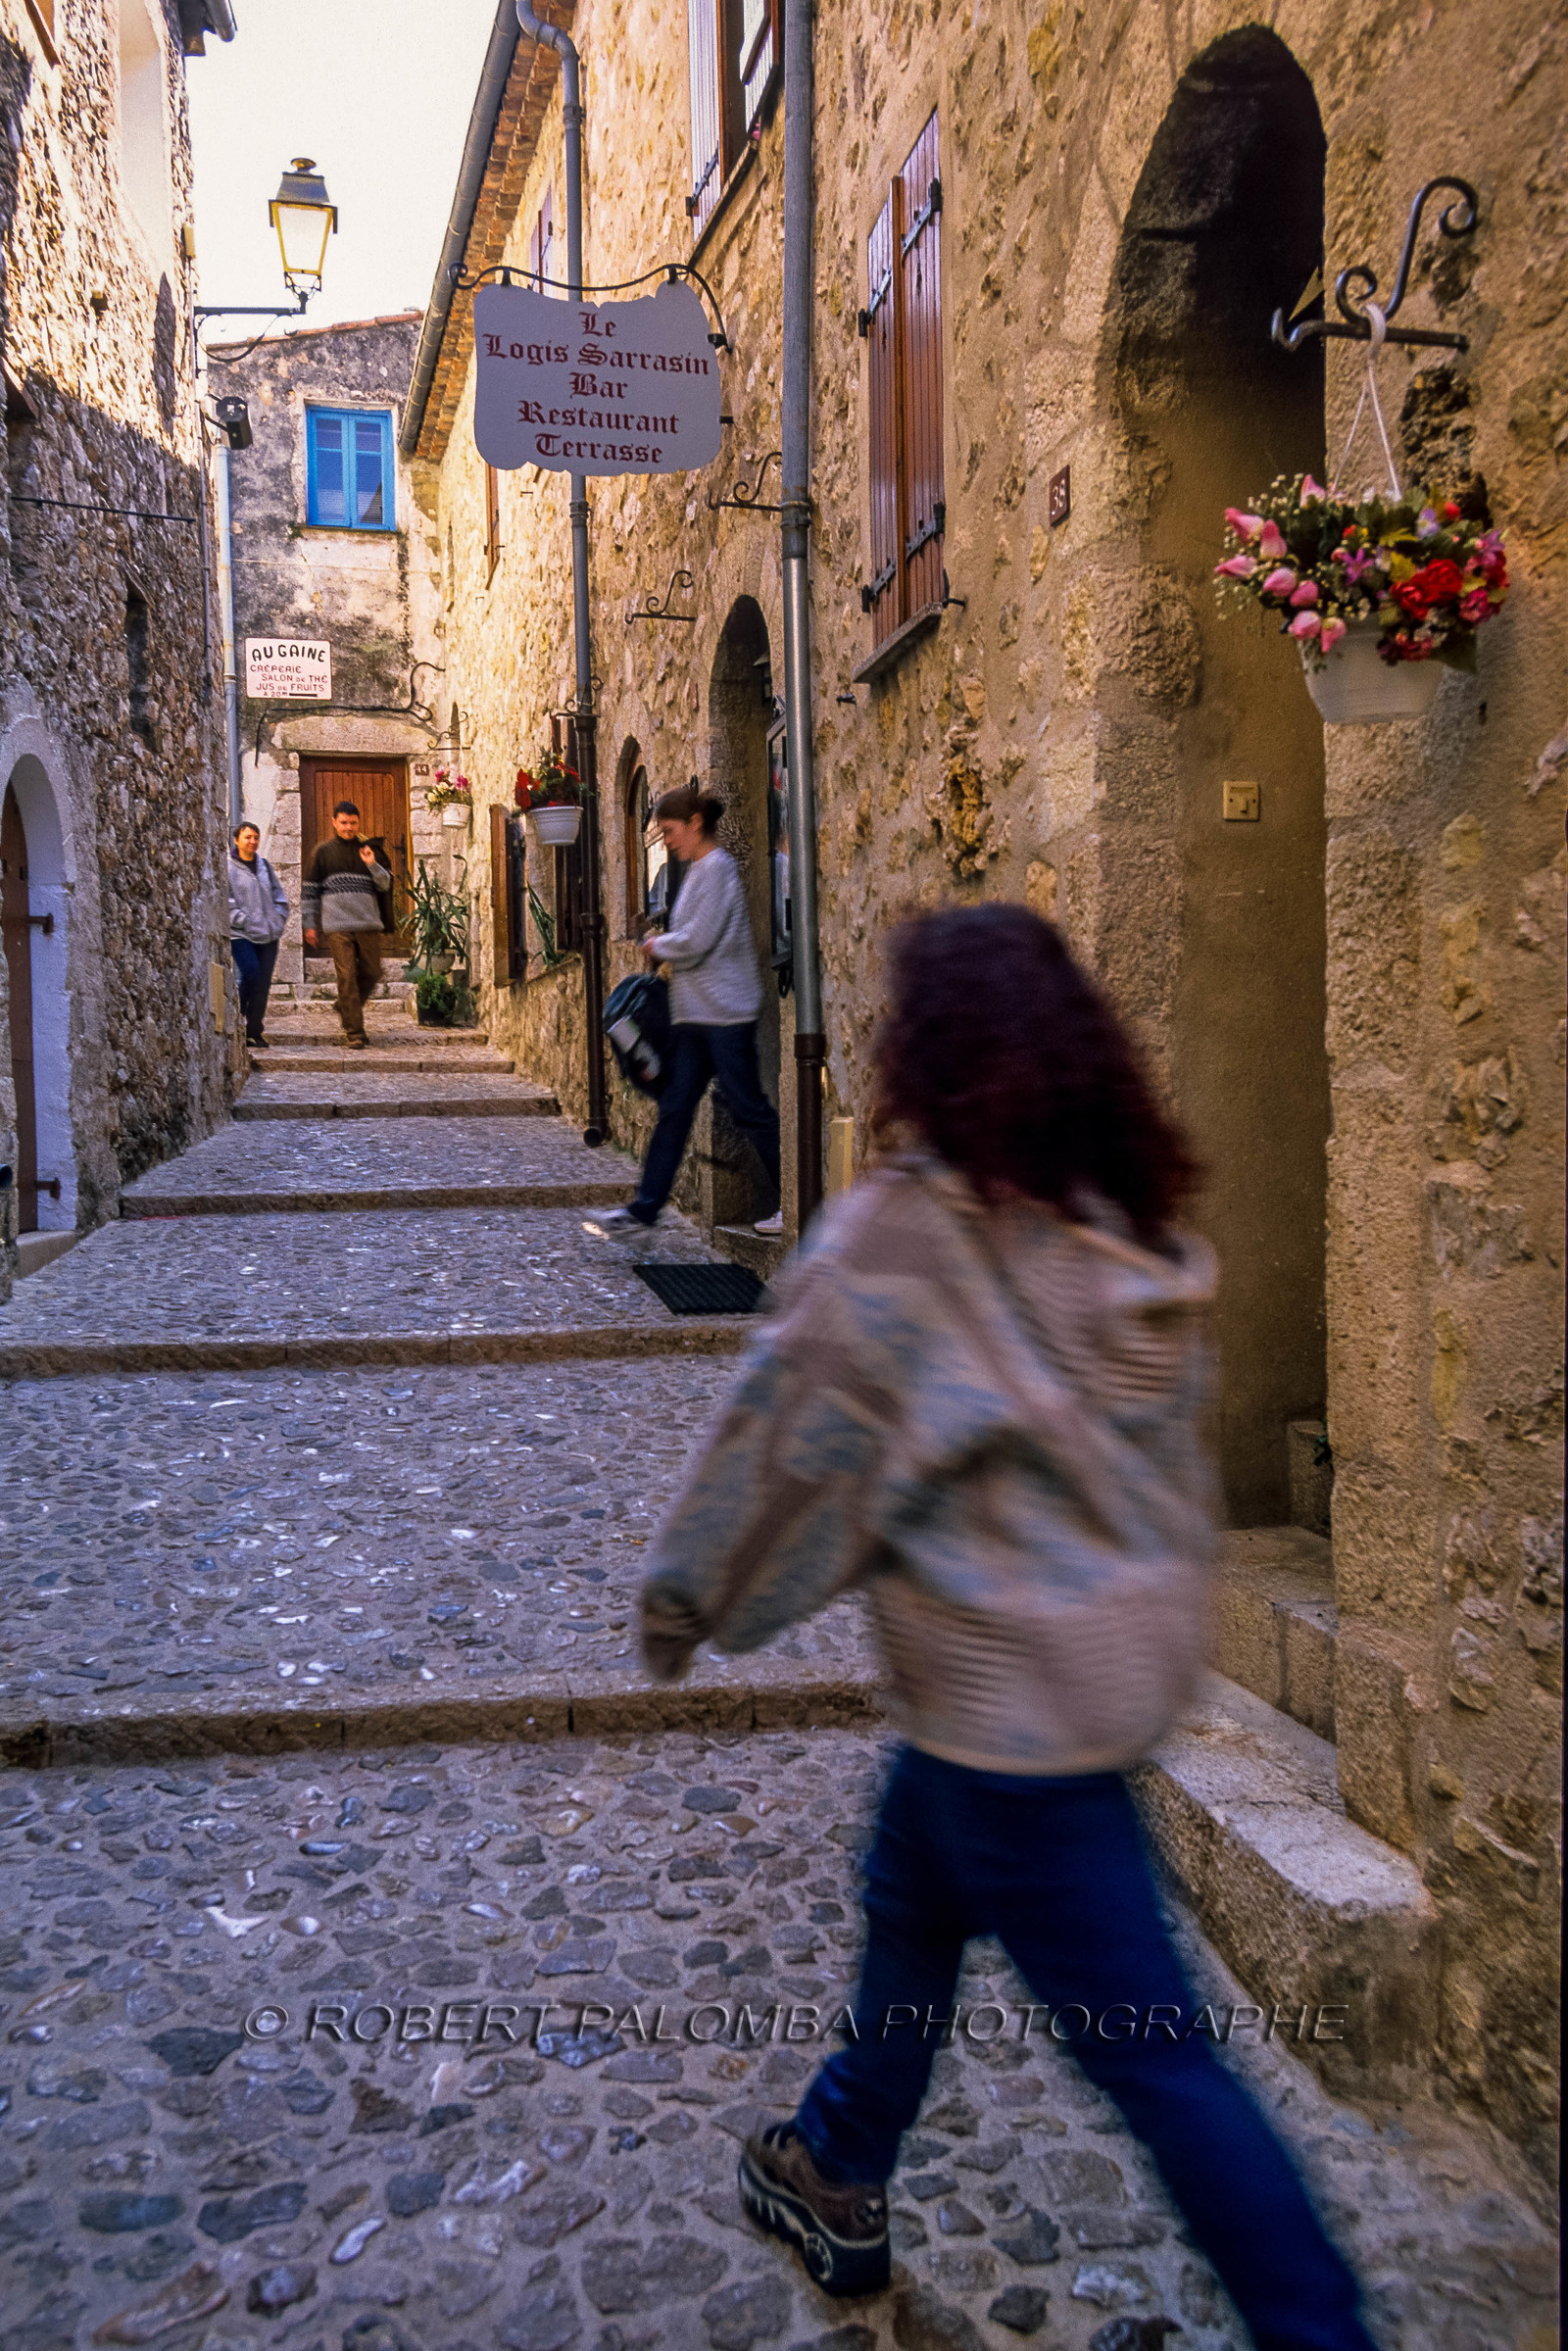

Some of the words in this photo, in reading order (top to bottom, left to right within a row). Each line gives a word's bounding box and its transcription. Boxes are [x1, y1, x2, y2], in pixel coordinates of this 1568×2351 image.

[577, 311, 617, 338] Le
[481, 333, 569, 367] Logis
[577, 342, 710, 376] Sarrasin
[567, 370, 629, 400] Bar
[516, 400, 680, 434] Restaurant
[534, 432, 663, 465] Terrasse
[1052, 478, 1065, 515] 38
[256, 682, 274, 691] JUS
[290, 683, 324, 692] FRUITS
